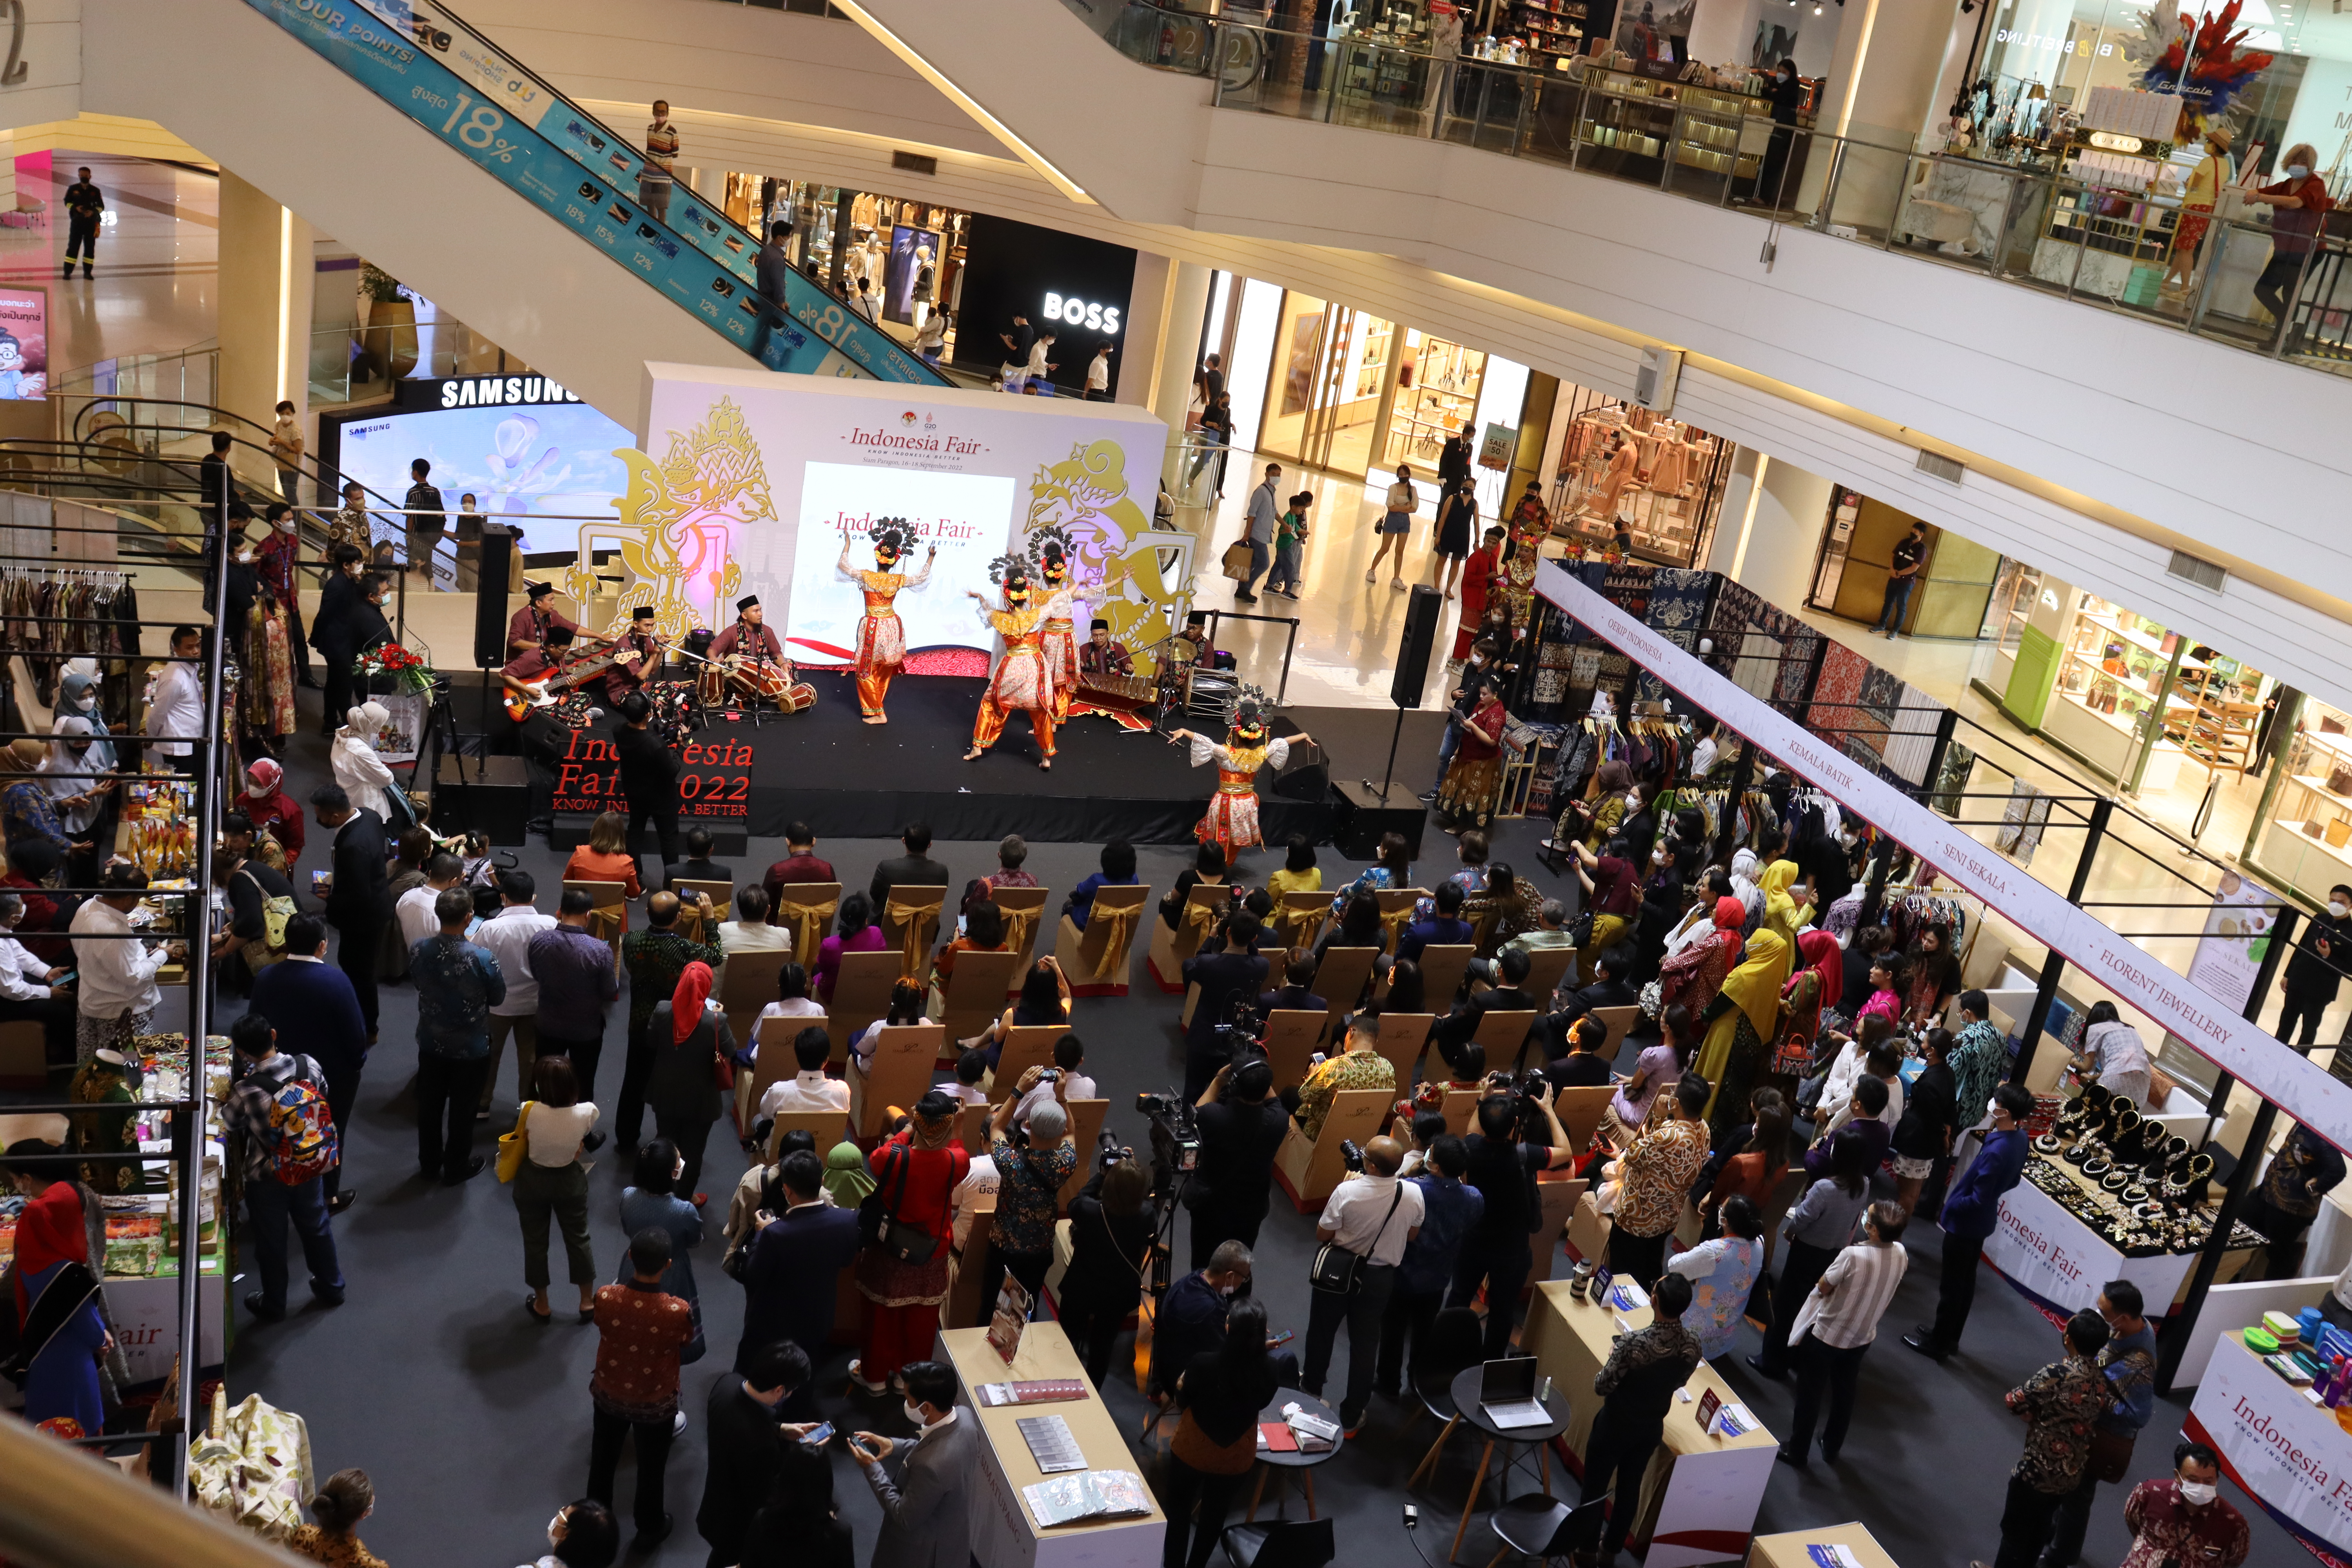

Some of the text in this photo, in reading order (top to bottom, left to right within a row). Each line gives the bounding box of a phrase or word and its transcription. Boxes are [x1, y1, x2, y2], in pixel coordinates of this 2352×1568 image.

[284, 0, 416, 65] OUR POINTS!
[1183, 31, 1196, 54] 2
[1228, 39, 1241, 63] 2
[411, 85, 448, 109] สูงสุด
[441, 93, 519, 163] 18%
[565, 204, 585, 224] 18%
[594, 224, 615, 244] 15%
[633, 251, 653, 270] 12%
[699, 298, 718, 317] 12%
[1043, 292, 1120, 334] BOSS
[726, 317, 745, 336] 12%
[349, 423, 390, 435] SAMSUNG
[850, 427, 981, 455] Indonesia Fair
[1489, 438, 1507, 449] SALE
[1491, 446, 1501, 455] 50
[877, 457, 900, 466] Paragon,
[919, 461, 947, 470] September
[1564, 482, 1608, 499] COLLECTION
[936, 519, 976, 539] Fair
[1608, 618, 1663, 662] OERIP INDONESIA
[563, 730, 753, 766] Inesia
[1788, 740, 1853, 790] KEMALA BATIK
[554, 764, 750, 800] Fai 022
[552, 798, 599, 810] KNOW
[695, 804, 748, 816] BETTER
[1943, 843, 2007, 893] SENI SEKALA
[2100, 949, 2159, 996] FLORENT
[2156, 987, 2234, 1045] JEWELLERY
[1996, 1200, 2082, 1281] donesia Fair
[2002, 1227, 2069, 1286] INDONESIA BETTER
[114, 1323, 163, 1345] air
[2232, 1395, 2352, 1515] Indonesia Fa
[2234, 1421, 2352, 1528] KNOW INDONESIA BETTE
